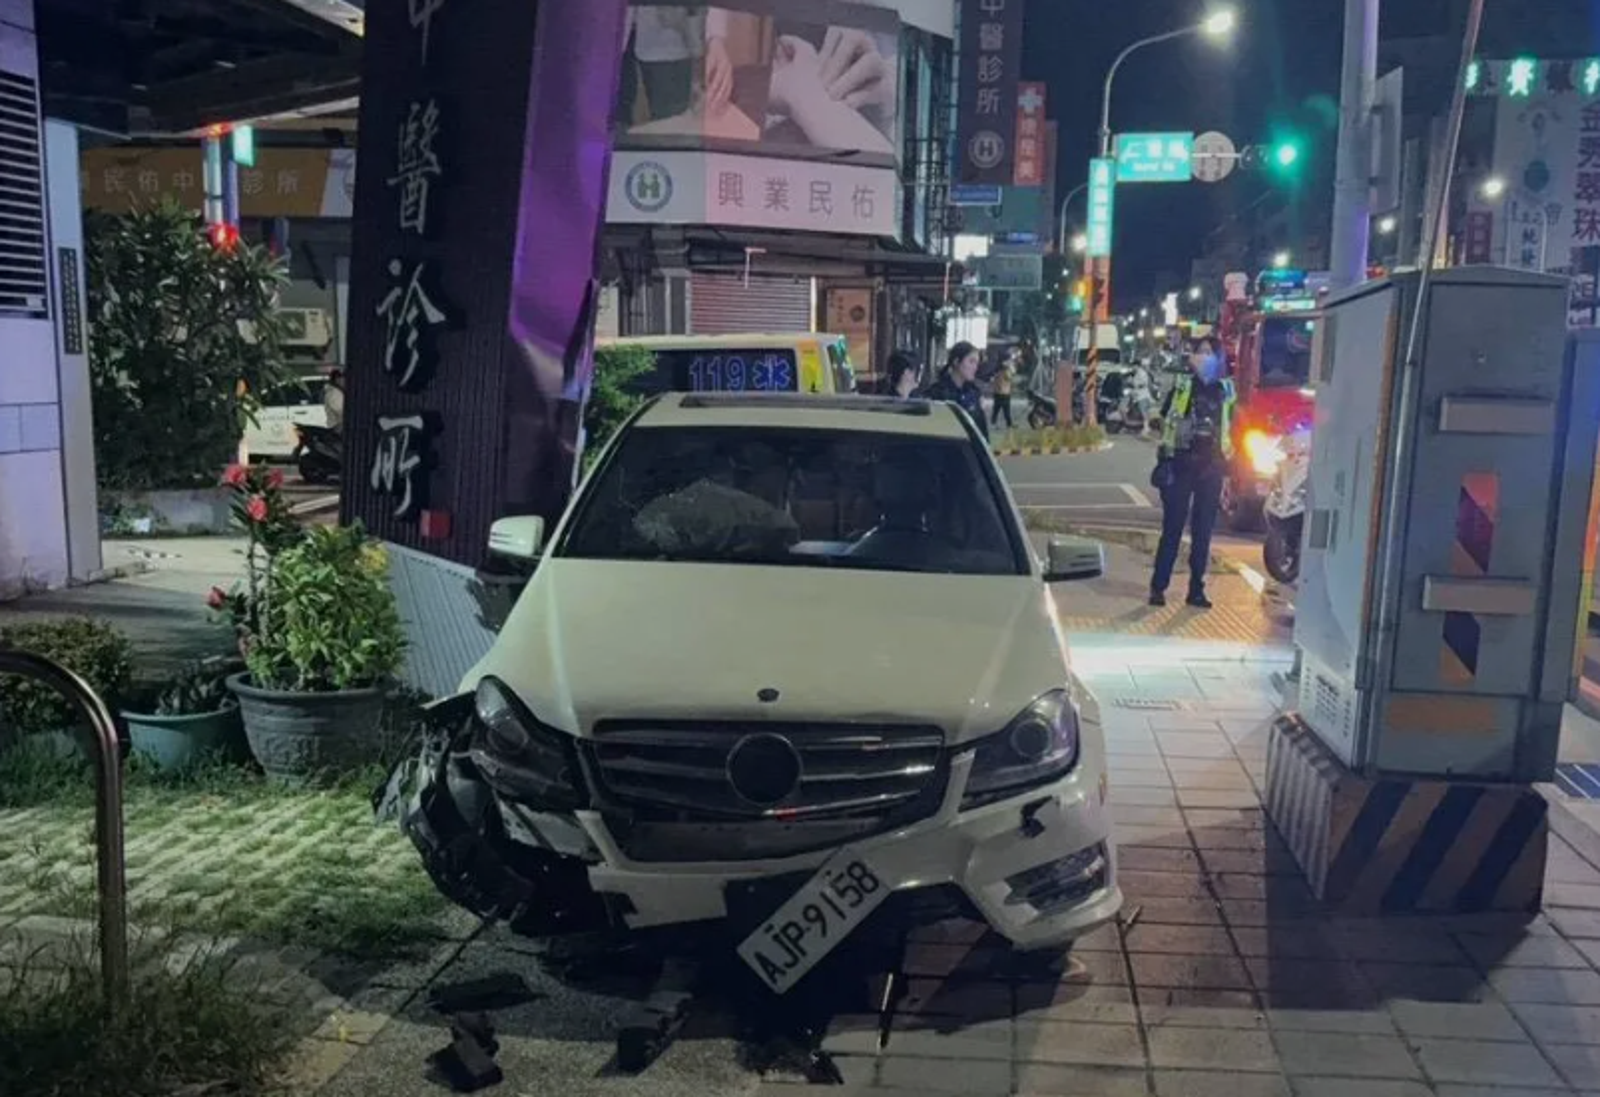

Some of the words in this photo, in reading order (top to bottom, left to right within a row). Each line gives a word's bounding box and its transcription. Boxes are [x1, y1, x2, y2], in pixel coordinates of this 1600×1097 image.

[976, 0, 1004, 114] 中醫診所
[84, 168, 299, 195] 民佑中診所
[718, 171, 876, 218] 興業民佑
[689, 355, 746, 392] 119
[754, 861, 880, 984] AJP-9158
